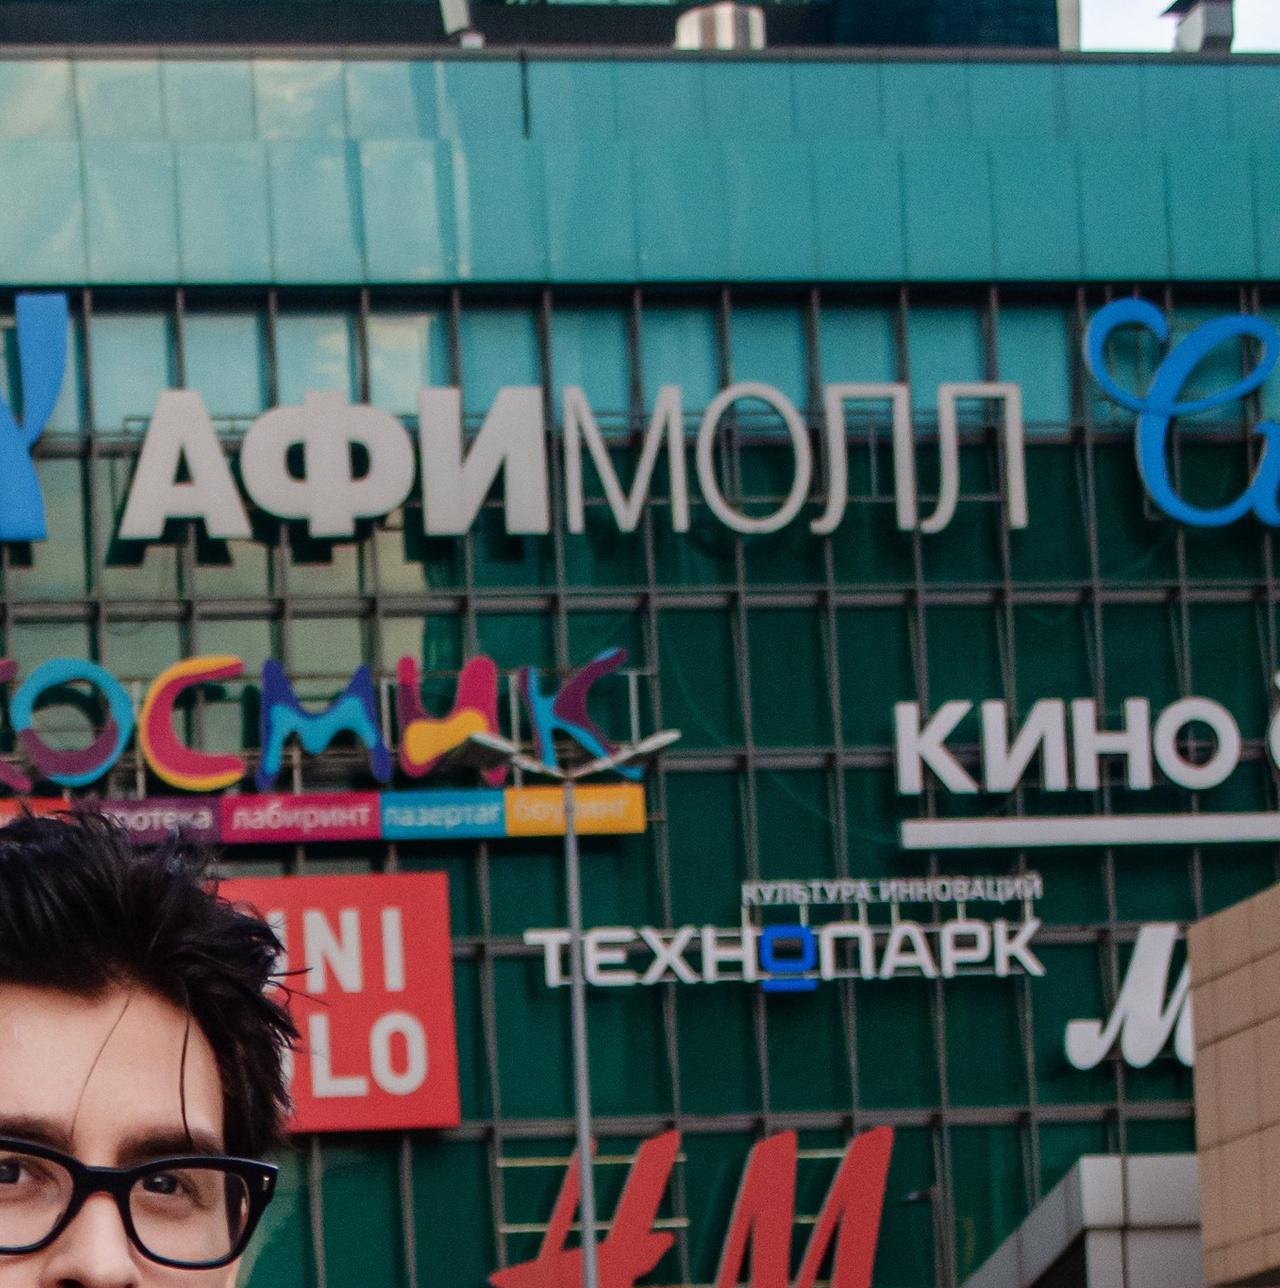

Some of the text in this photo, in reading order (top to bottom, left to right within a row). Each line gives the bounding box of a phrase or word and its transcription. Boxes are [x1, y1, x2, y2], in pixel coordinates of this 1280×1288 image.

[119, 382, 1029, 541] АФИМОЛЛ
[893, 696, 1243, 795] КИНО
[231, 800, 371, 835] лабиринт
[740, 869, 1044, 905] КУЛЬТУРА ИННОВАЦИЙ
[522, 918, 1047, 991] ТЕХНОПАРК
[276, 1011, 429, 1098] LO
